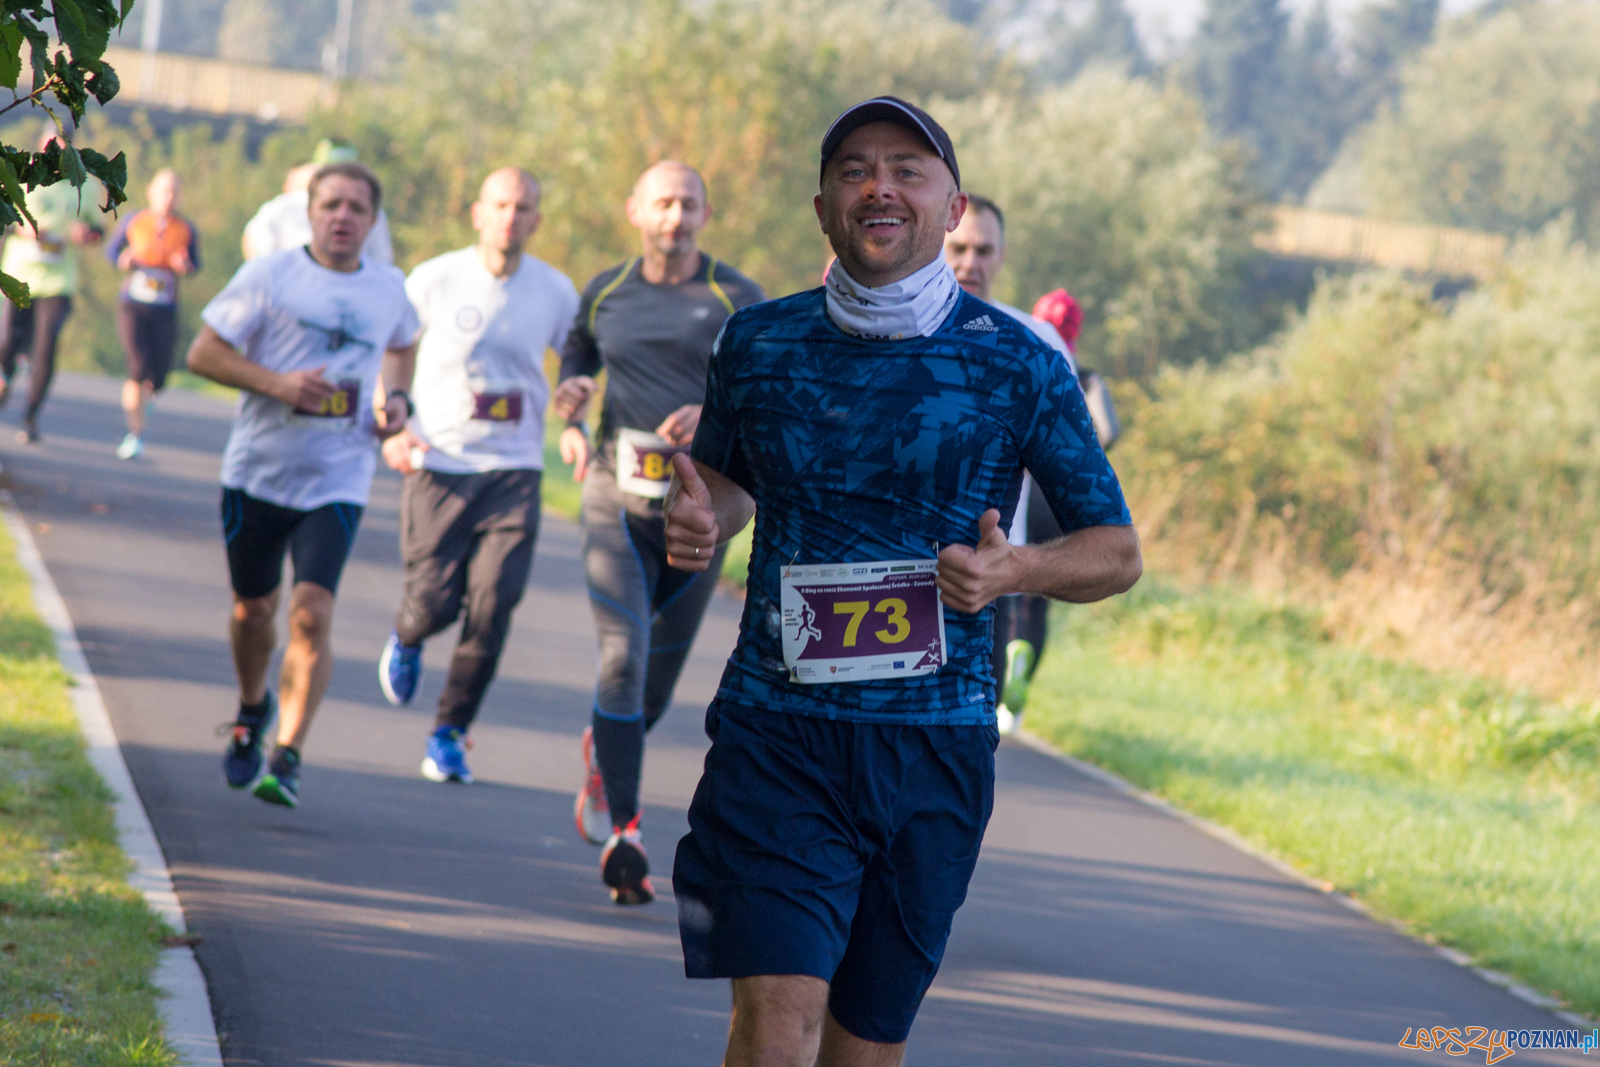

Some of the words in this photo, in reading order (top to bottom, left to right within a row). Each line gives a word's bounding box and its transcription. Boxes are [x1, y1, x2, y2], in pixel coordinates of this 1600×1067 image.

[962, 322, 999, 333] adidas
[489, 397, 509, 420] 4
[805, 587, 817, 595] Bieg
[863, 583, 891, 592] Społecznej
[833, 598, 911, 647] 73
